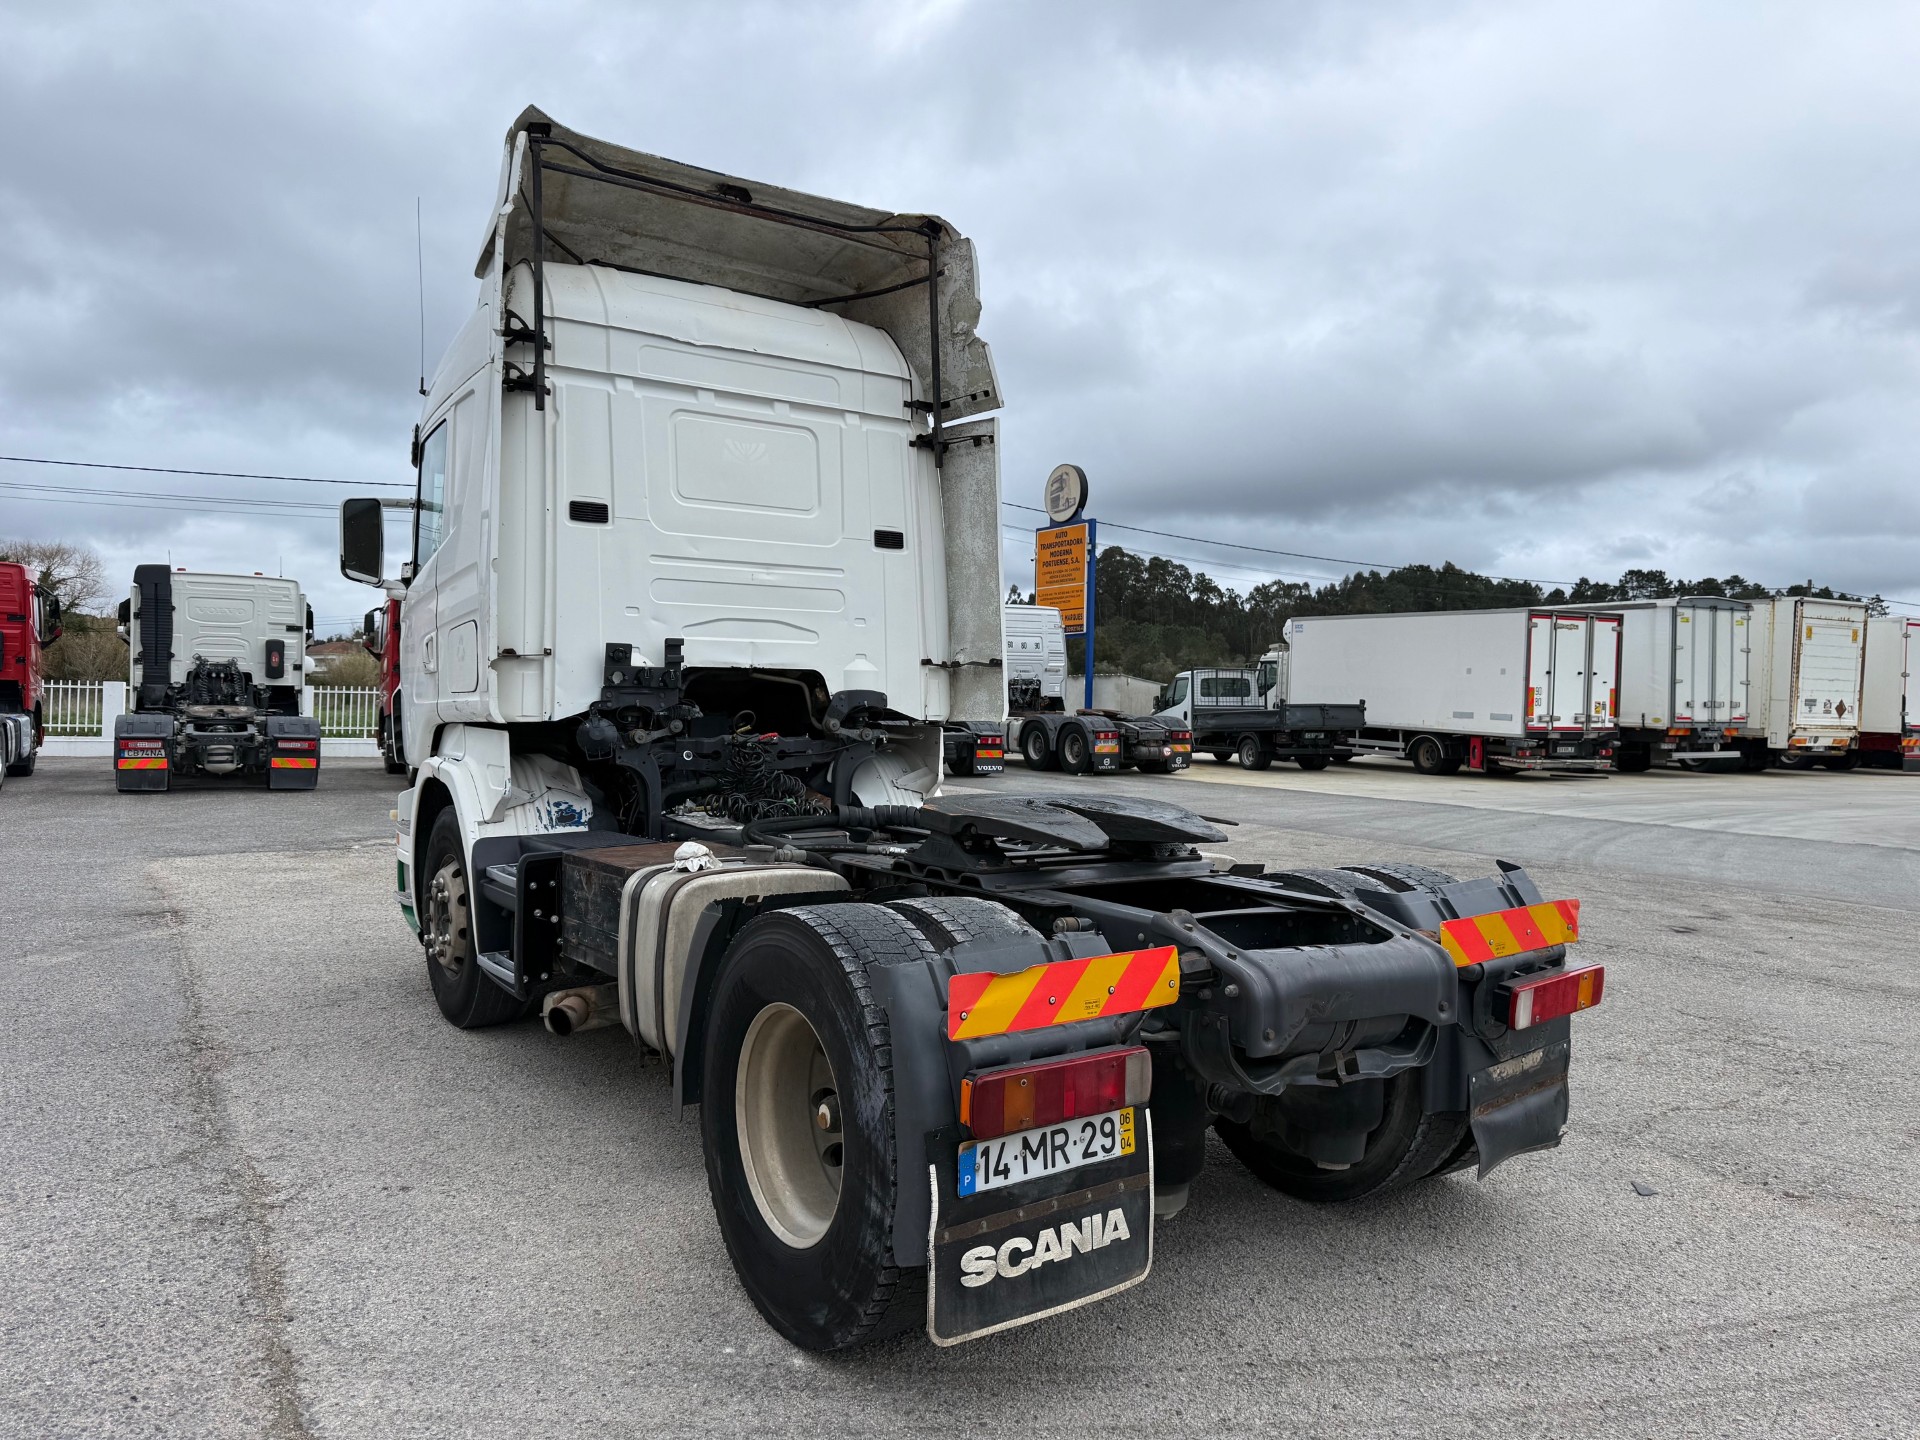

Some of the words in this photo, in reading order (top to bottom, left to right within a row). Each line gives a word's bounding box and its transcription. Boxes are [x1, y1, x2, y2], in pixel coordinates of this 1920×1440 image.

[1055, 531, 1068, 539] AUTO
[1040, 538, 1083, 550] TRANSPORTADORA
[1050, 549, 1072, 558] MODERNA
[195, 606, 246, 615] VOLVO
[1119, 1112, 1131, 1126] 06
[1120, 1136, 1132, 1150] 04
[964, 1175, 971, 1187] P
[960, 1207, 1131, 1288] SCANIA
